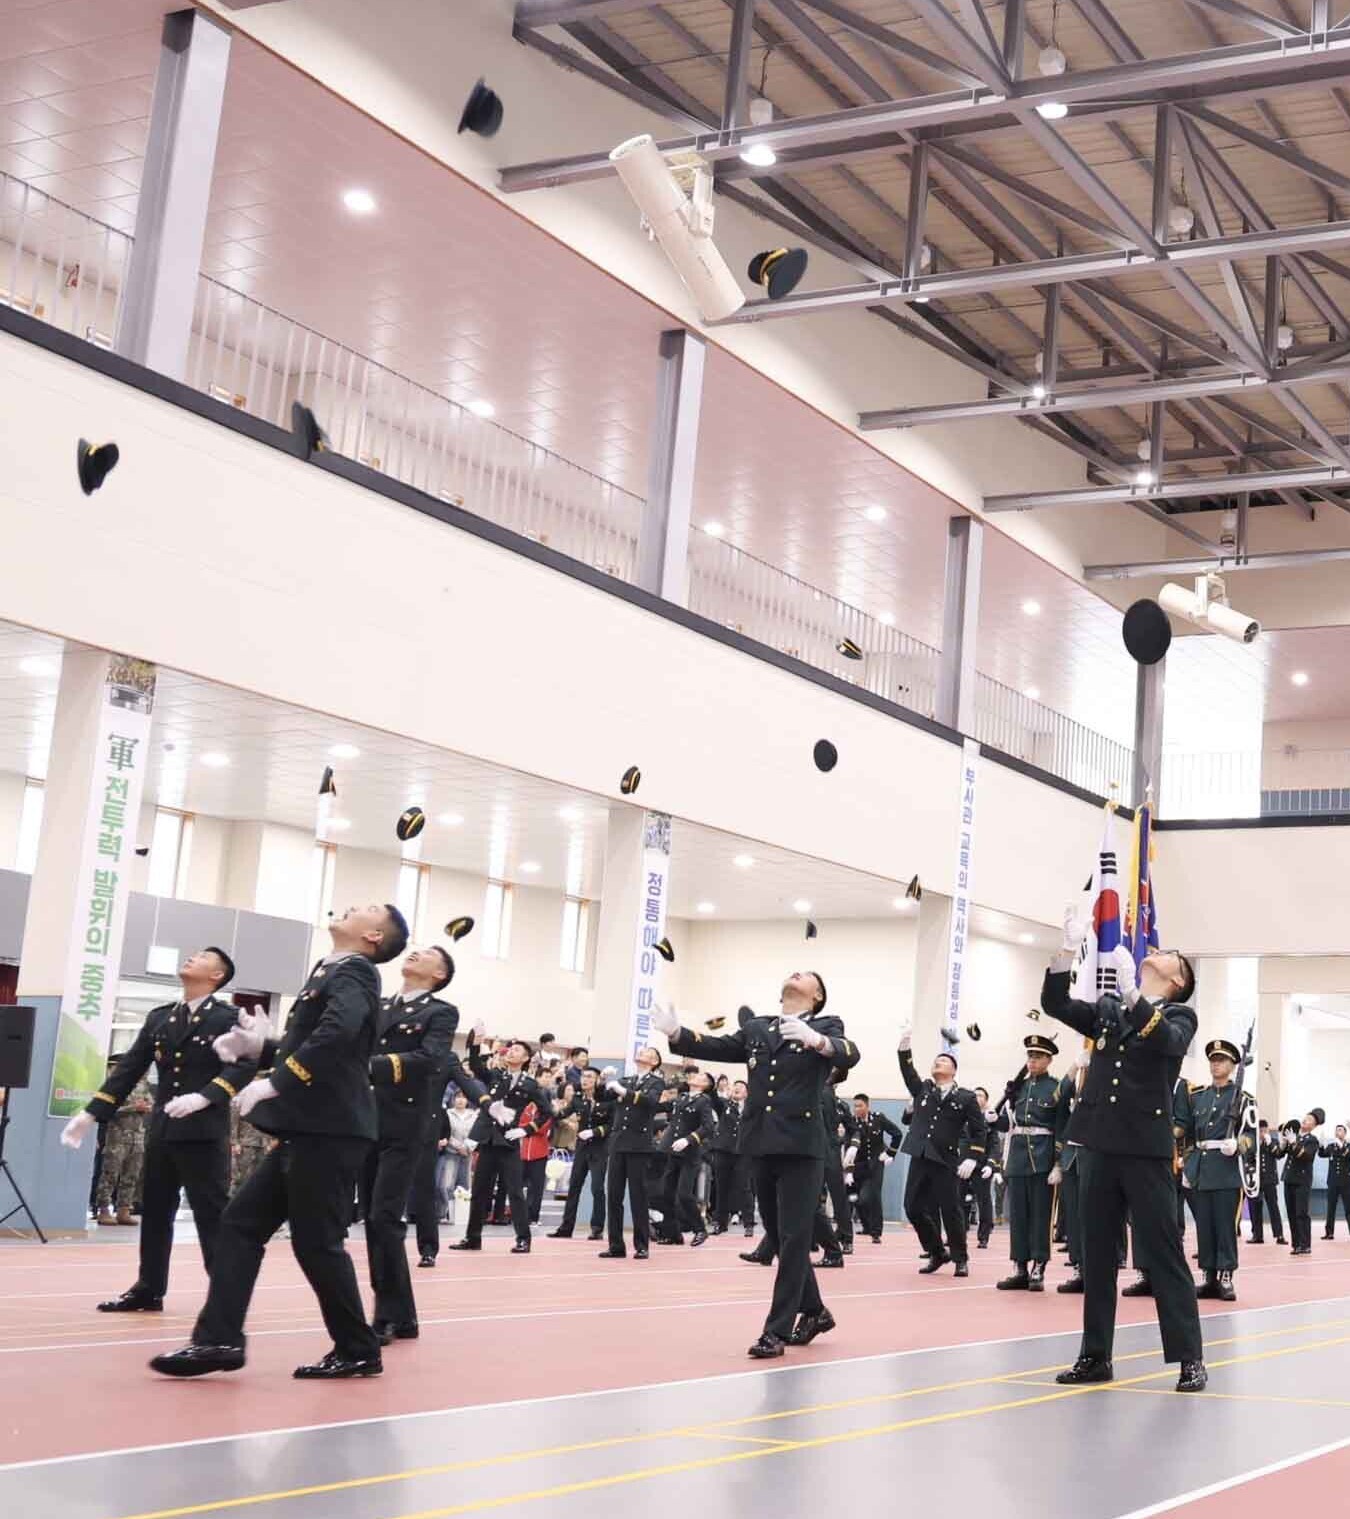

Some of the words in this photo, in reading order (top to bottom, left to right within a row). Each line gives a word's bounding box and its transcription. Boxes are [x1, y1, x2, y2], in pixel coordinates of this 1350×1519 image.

[107, 732, 140, 771] 軍
[97, 774, 129, 864] 전투력
[963, 766, 976, 826] 부사관
[84, 868, 119, 957] 발휘의
[641, 872, 663, 976] 정통해야
[76, 963, 104, 1022] 중추
